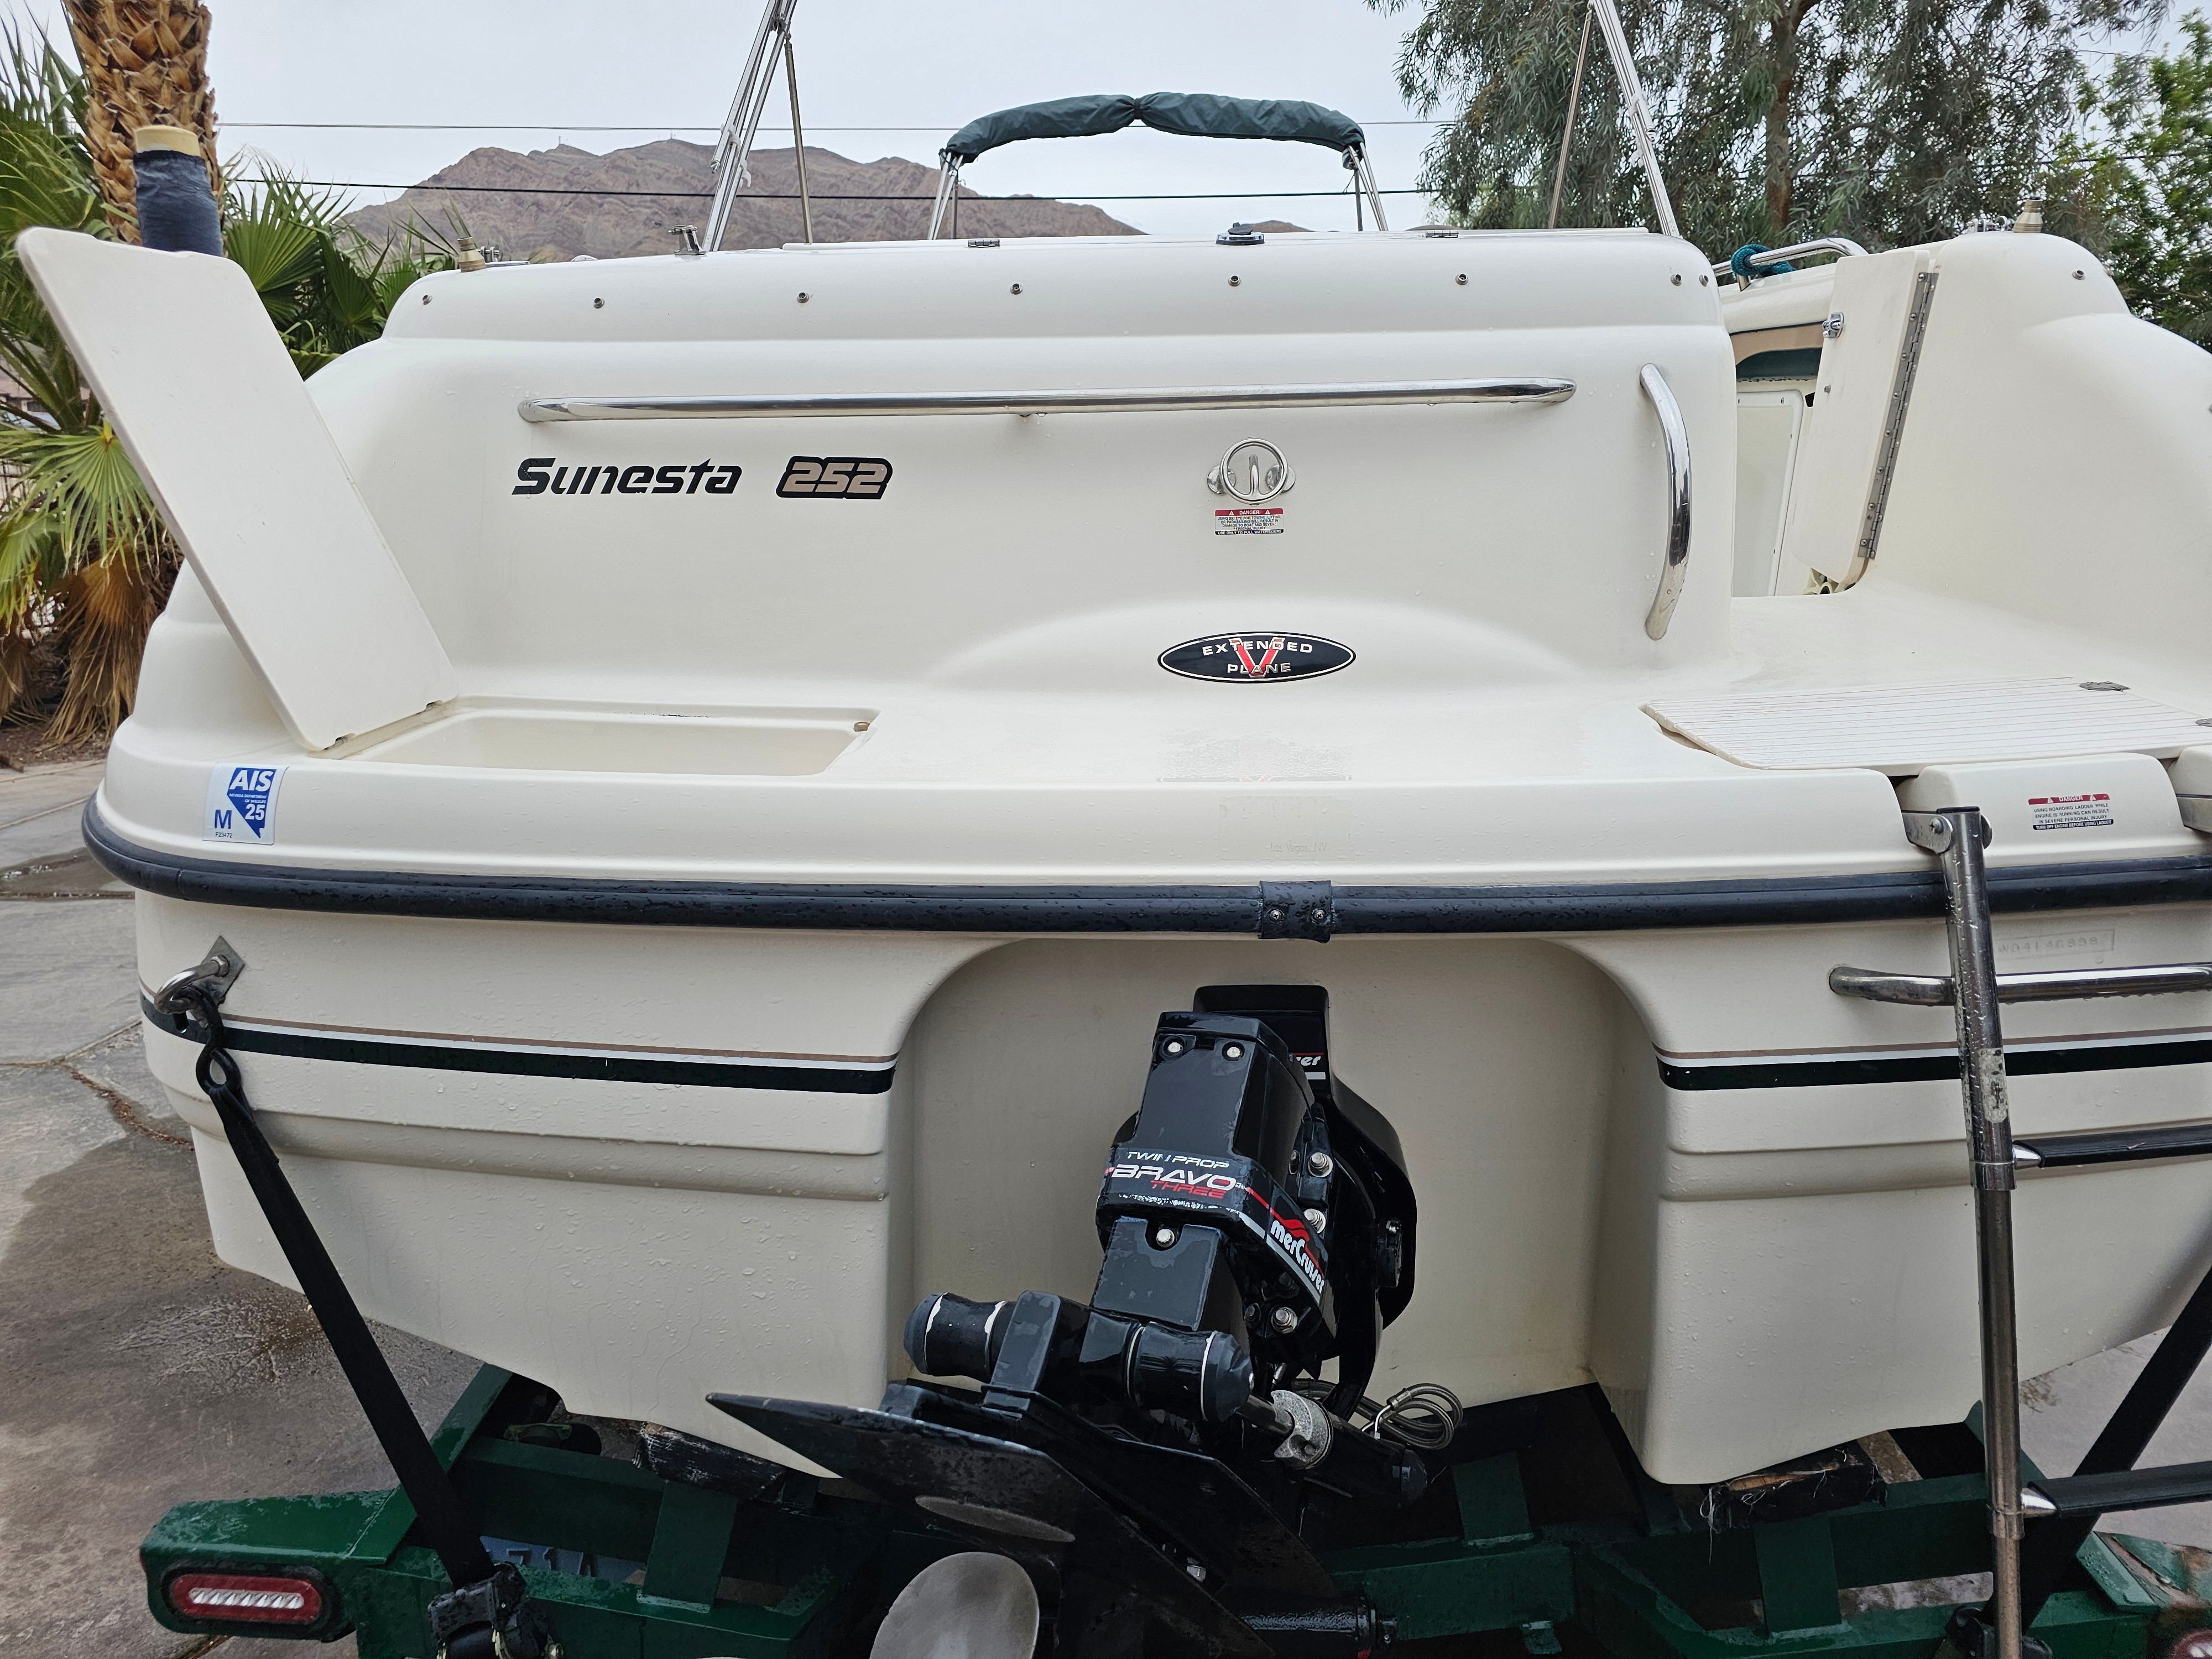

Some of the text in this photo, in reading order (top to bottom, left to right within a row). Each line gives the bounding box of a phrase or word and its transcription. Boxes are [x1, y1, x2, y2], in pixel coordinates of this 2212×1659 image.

[512, 457, 890, 496] Sunesta 252
[1202, 640, 1312, 656] EXTENDED
[1227, 663, 1291, 676] PLANE
[229, 769, 274, 792] AIS
[215, 810, 232, 829] M
[245, 804, 265, 821] 25
[1270, 842, 1283, 852] Las
[1126, 1151, 1229, 1168] TWIN PROP
[1112, 1164, 1237, 1191] BRAVO
[1150, 1180, 1227, 1199] THREE
